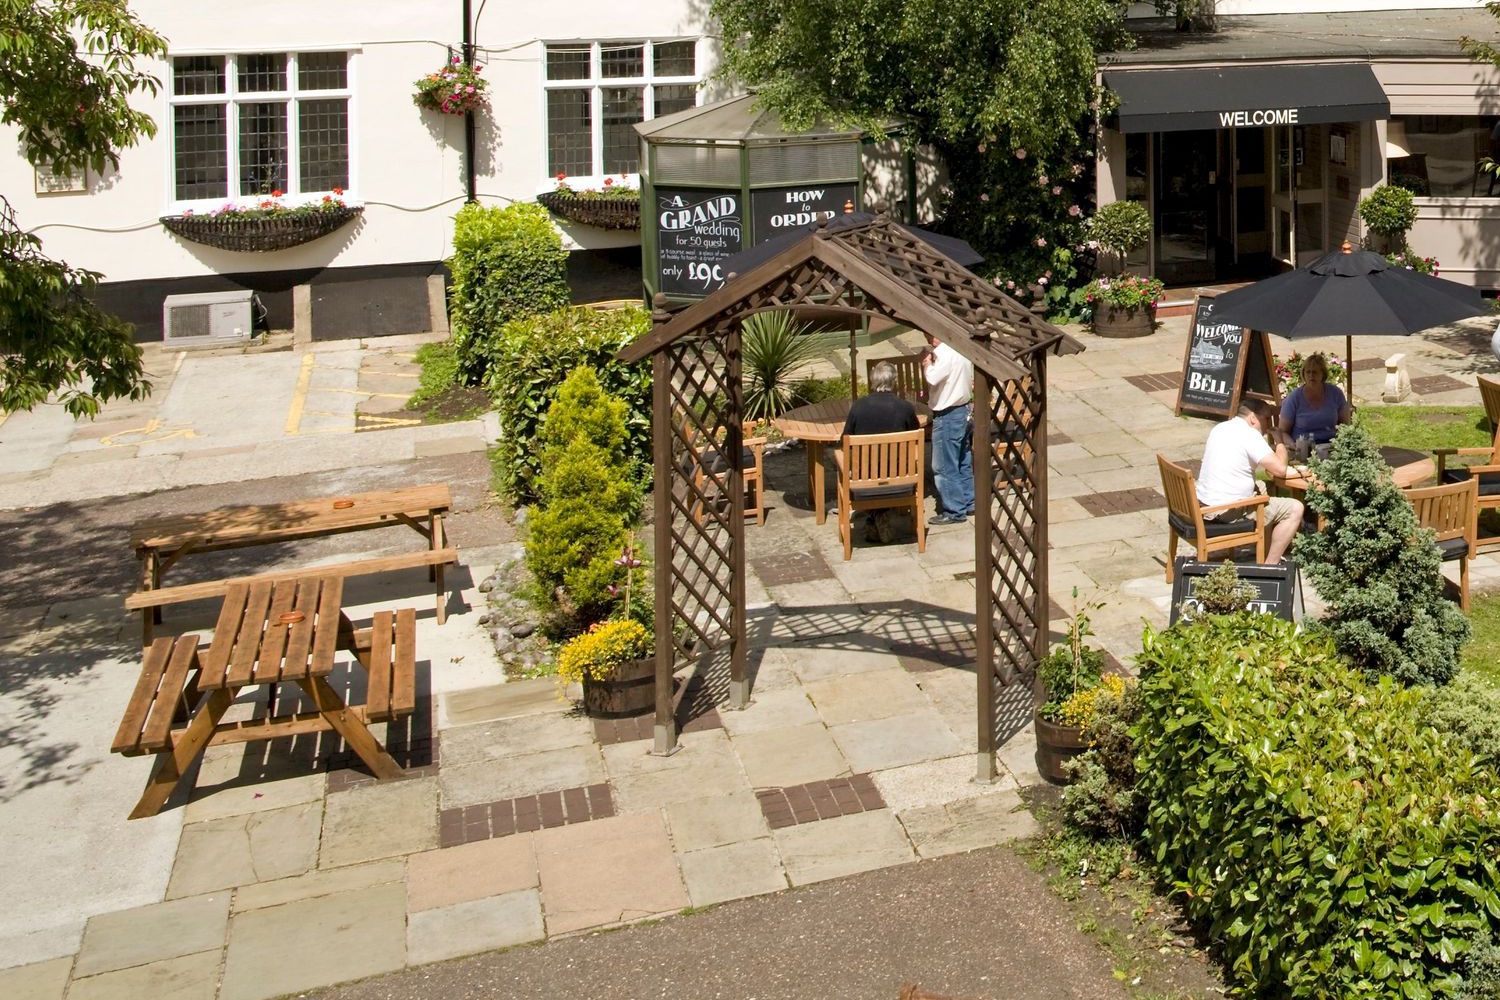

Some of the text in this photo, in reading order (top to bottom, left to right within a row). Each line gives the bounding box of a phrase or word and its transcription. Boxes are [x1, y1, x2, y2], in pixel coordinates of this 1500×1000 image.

[1219, 108, 1299, 127] WELCOME
[671, 195, 684, 207] A
[786, 189, 825, 203] HOW
[660, 196, 736, 229] GRAND
[802, 203, 811, 211] to
[694, 221, 740, 242] wedding
[676, 234, 727, 249] for 50 guests
[662, 264, 683, 280] only
[1222, 332, 1242, 346] you
[1225, 348, 1234, 359] to
[1189, 371, 1230, 396] BELL
